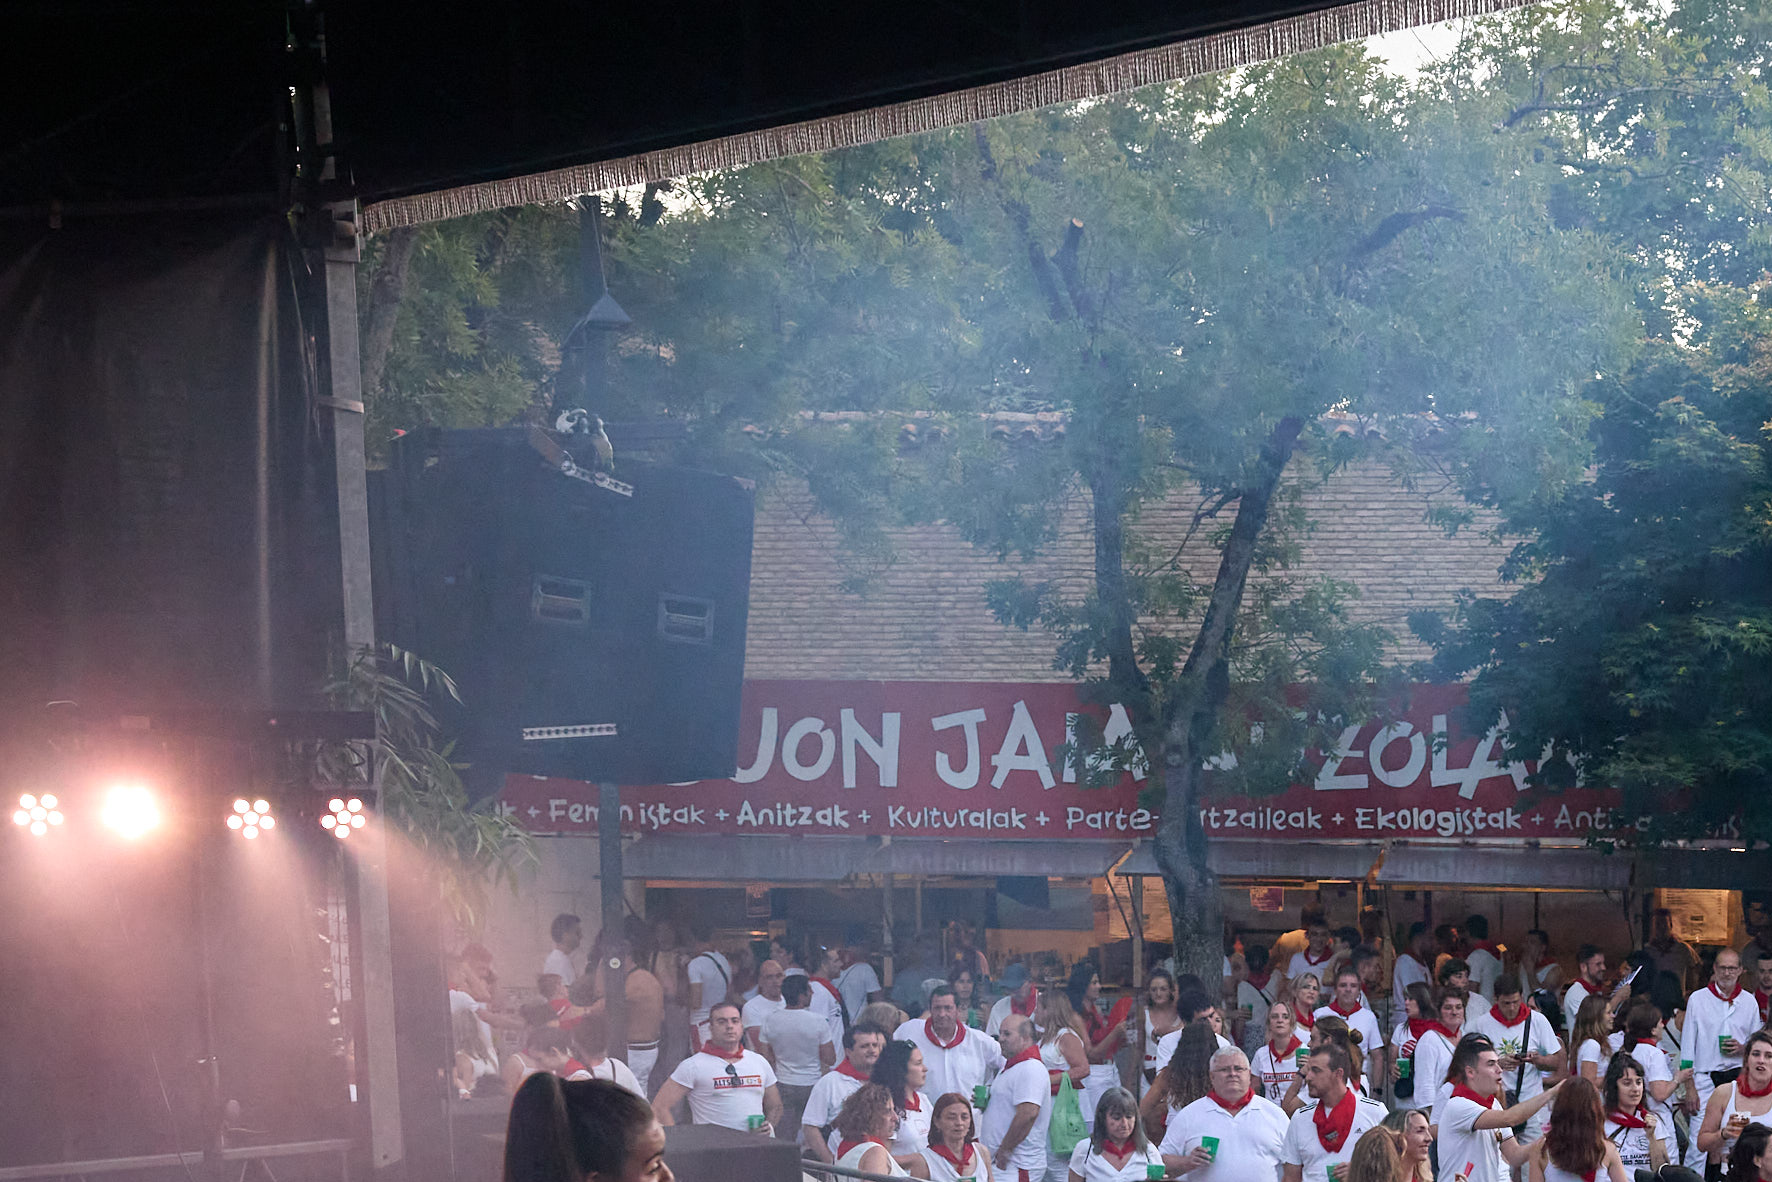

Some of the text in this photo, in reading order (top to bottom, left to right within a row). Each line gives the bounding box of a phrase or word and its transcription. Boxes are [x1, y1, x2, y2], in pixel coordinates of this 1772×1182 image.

[550, 799, 705, 830] Femnistak
[736, 800, 850, 828] Anitzak
[888, 805, 1027, 831] Kulturalak
[1355, 806, 1522, 836] Ekologistak
